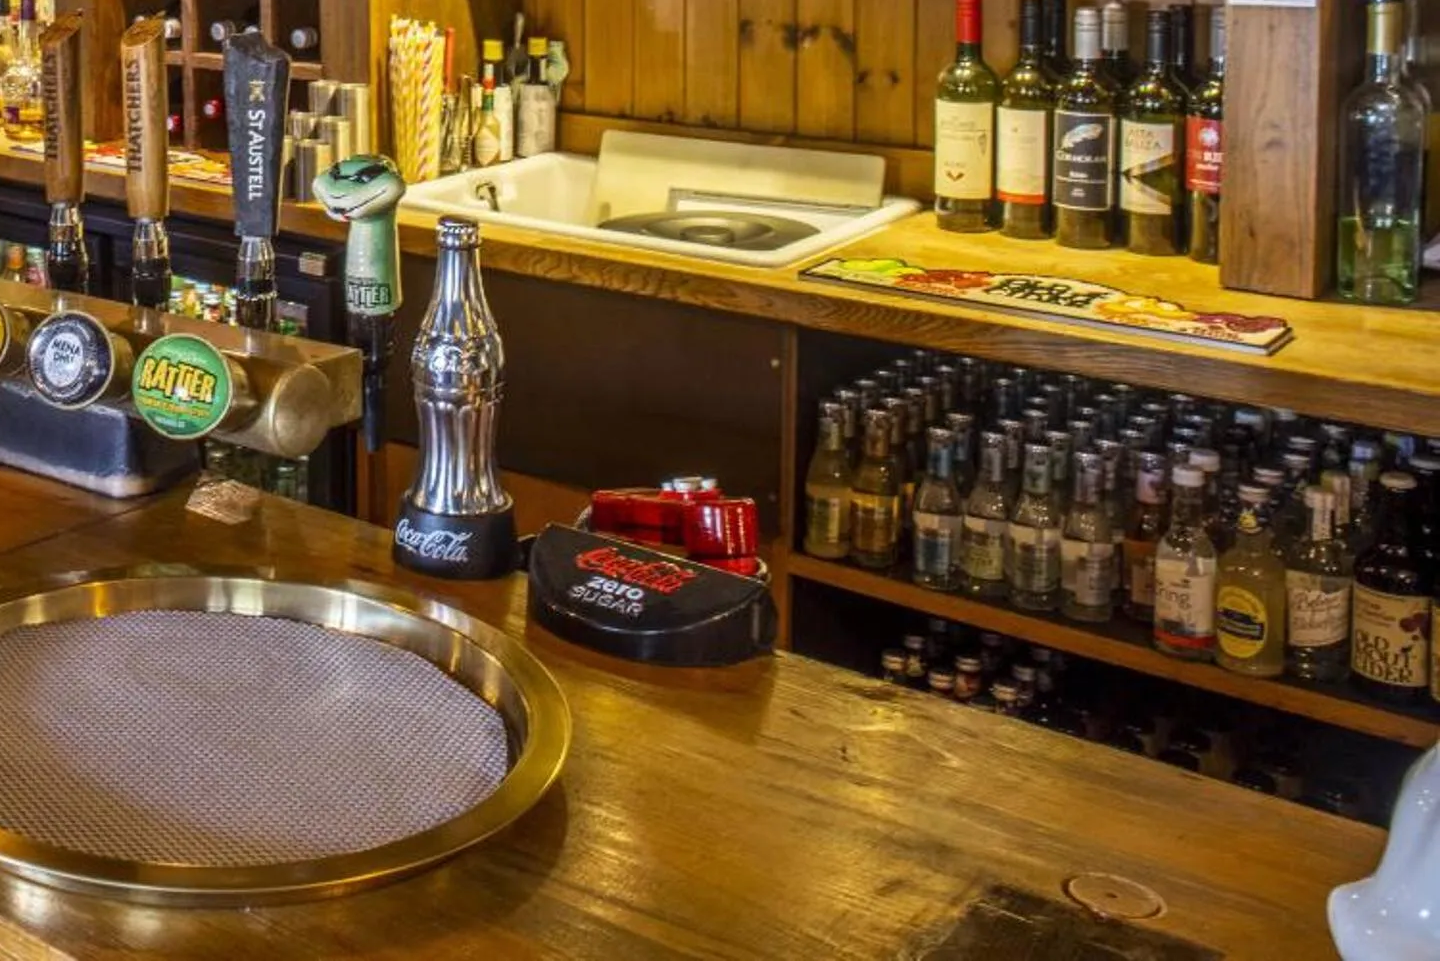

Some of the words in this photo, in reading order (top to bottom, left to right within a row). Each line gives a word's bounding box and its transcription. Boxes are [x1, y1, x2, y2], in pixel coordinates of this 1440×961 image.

[125, 57, 142, 173] THATCHERS
[247, 134, 266, 201] AUSTELL
[347, 283, 391, 308] ATTLER
[138, 355, 218, 404] RATTLER
[394, 518, 476, 564] Coca-Cola
[575, 546, 701, 595] Coca-Cola
[586, 575, 645, 601] zero
[569, 585, 645, 616] SUGAR
